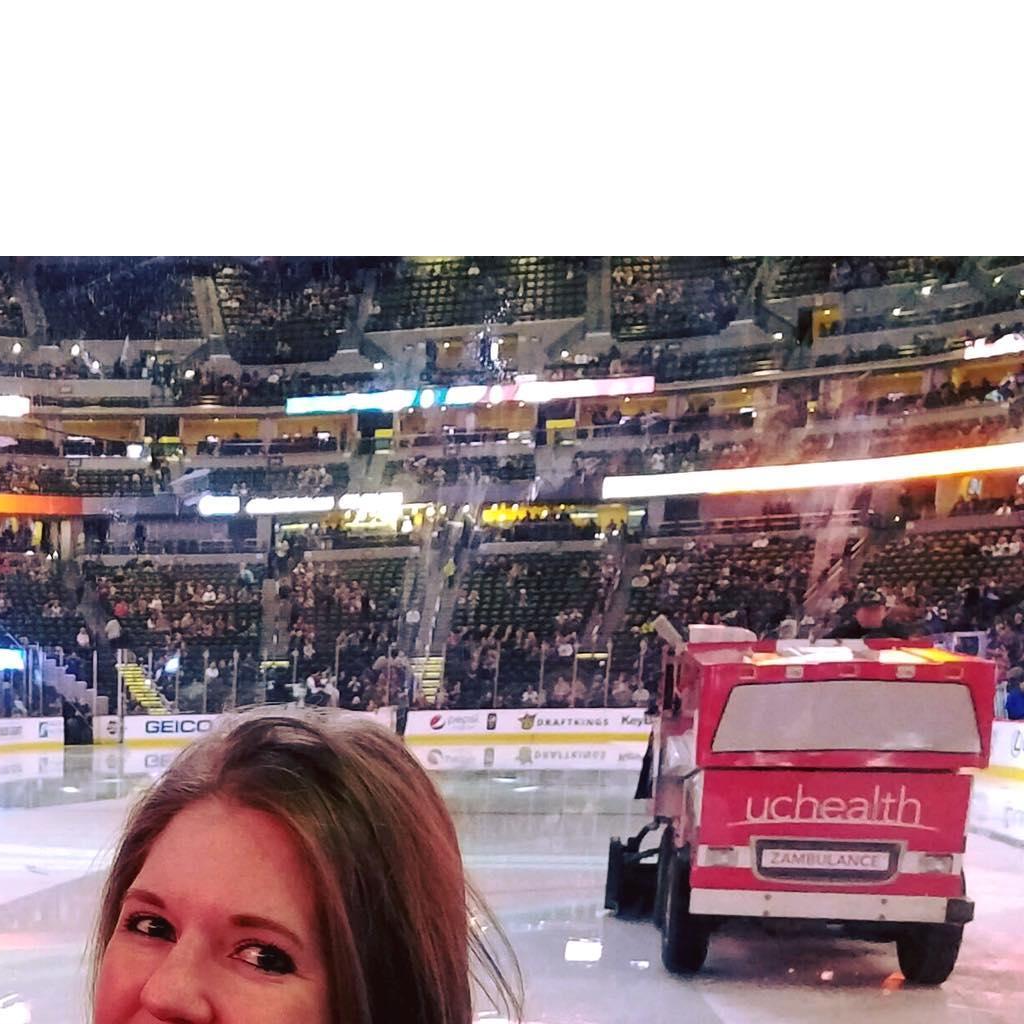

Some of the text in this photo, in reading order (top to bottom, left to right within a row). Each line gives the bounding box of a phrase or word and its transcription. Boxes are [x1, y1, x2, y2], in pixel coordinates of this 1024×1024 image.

[145, 720, 212, 733] GEICO
[537, 718, 609, 727] DRAFTKINGS
[746, 784, 921, 825] uchealth
[770, 852, 879, 868] ZAMBULANCE
